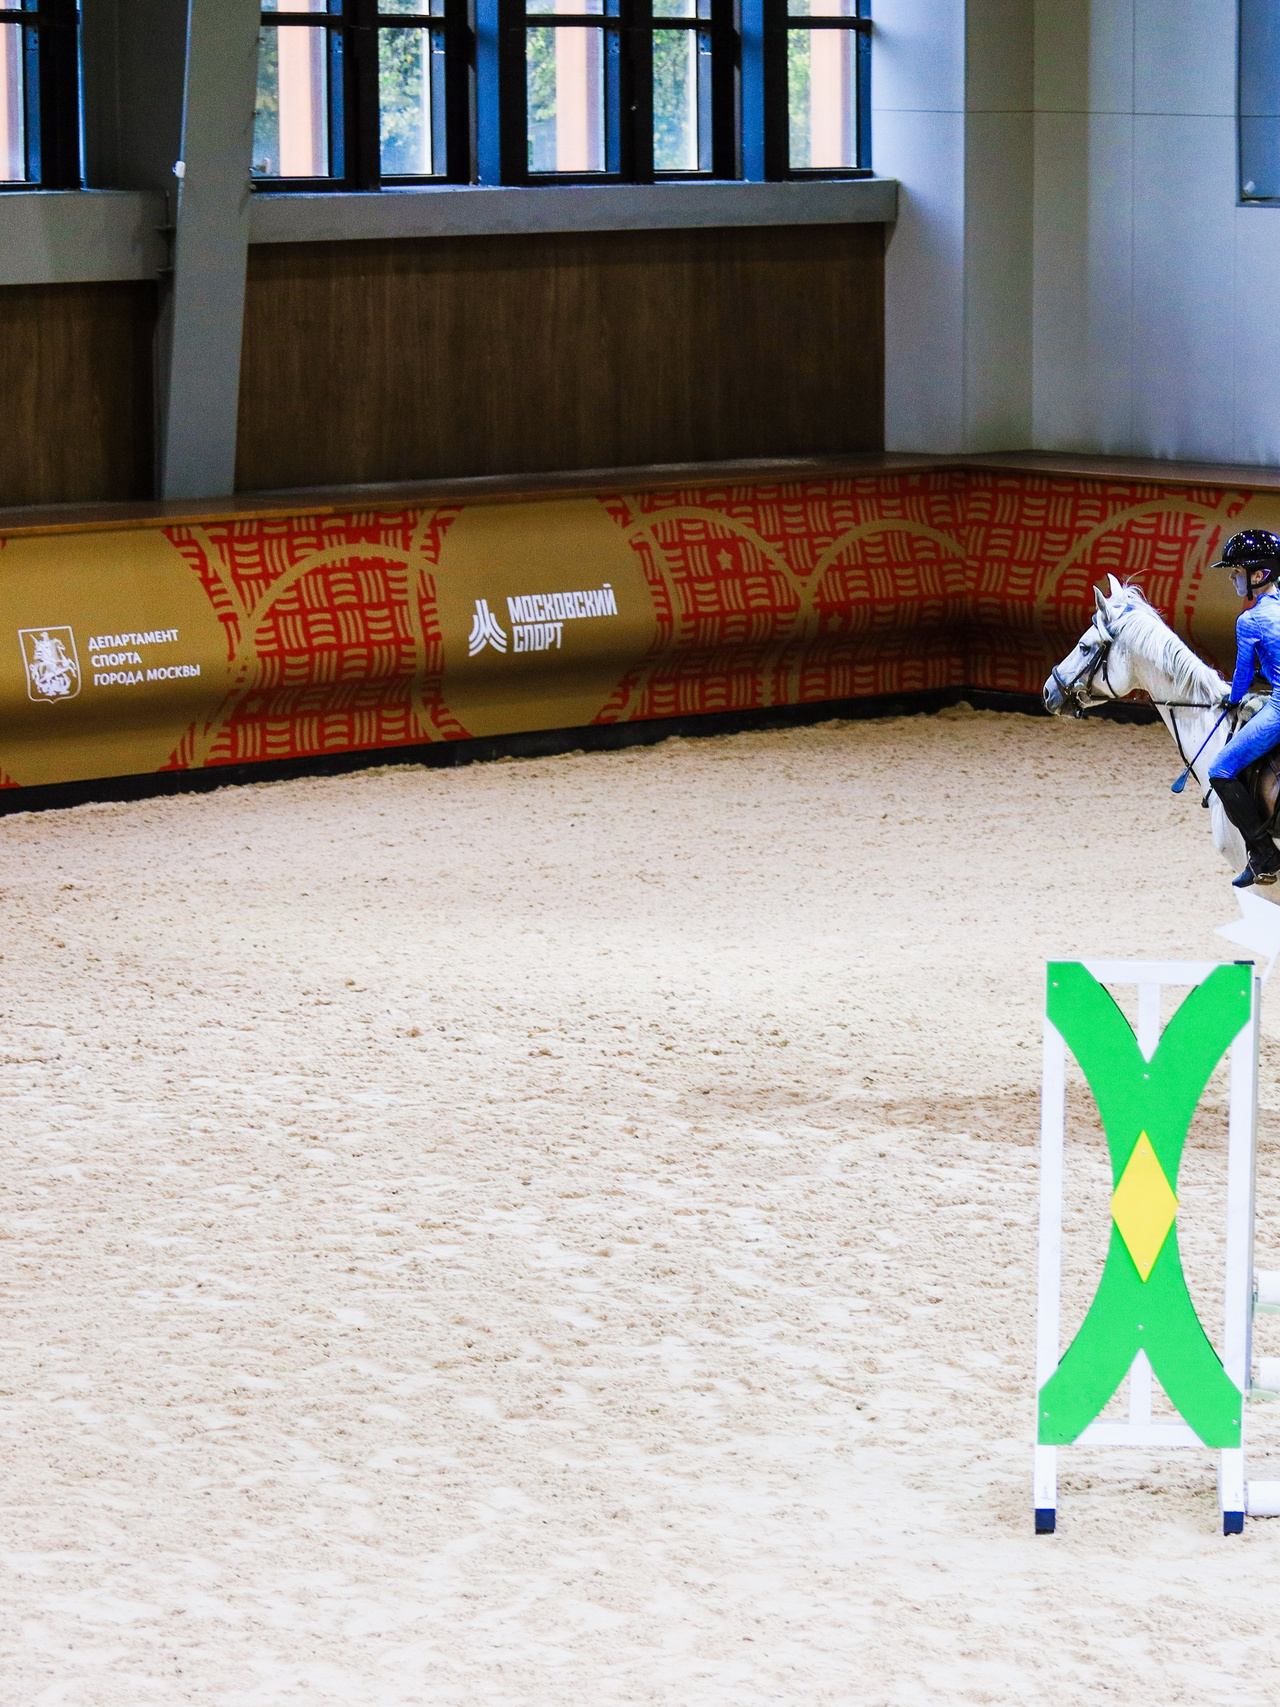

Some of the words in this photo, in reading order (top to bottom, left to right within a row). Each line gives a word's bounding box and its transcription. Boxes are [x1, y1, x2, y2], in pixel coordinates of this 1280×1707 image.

[507, 583, 618, 623] МОСКОВСКИЙ
[87, 629, 179, 651] ДЕПАРТАМЕНТ
[512, 622, 563, 652] СПОРТ
[90, 651, 143, 667] СПОРТА
[93, 669, 144, 686] ГОРОДА
[146, 664, 201, 681] МОСКВЫ
